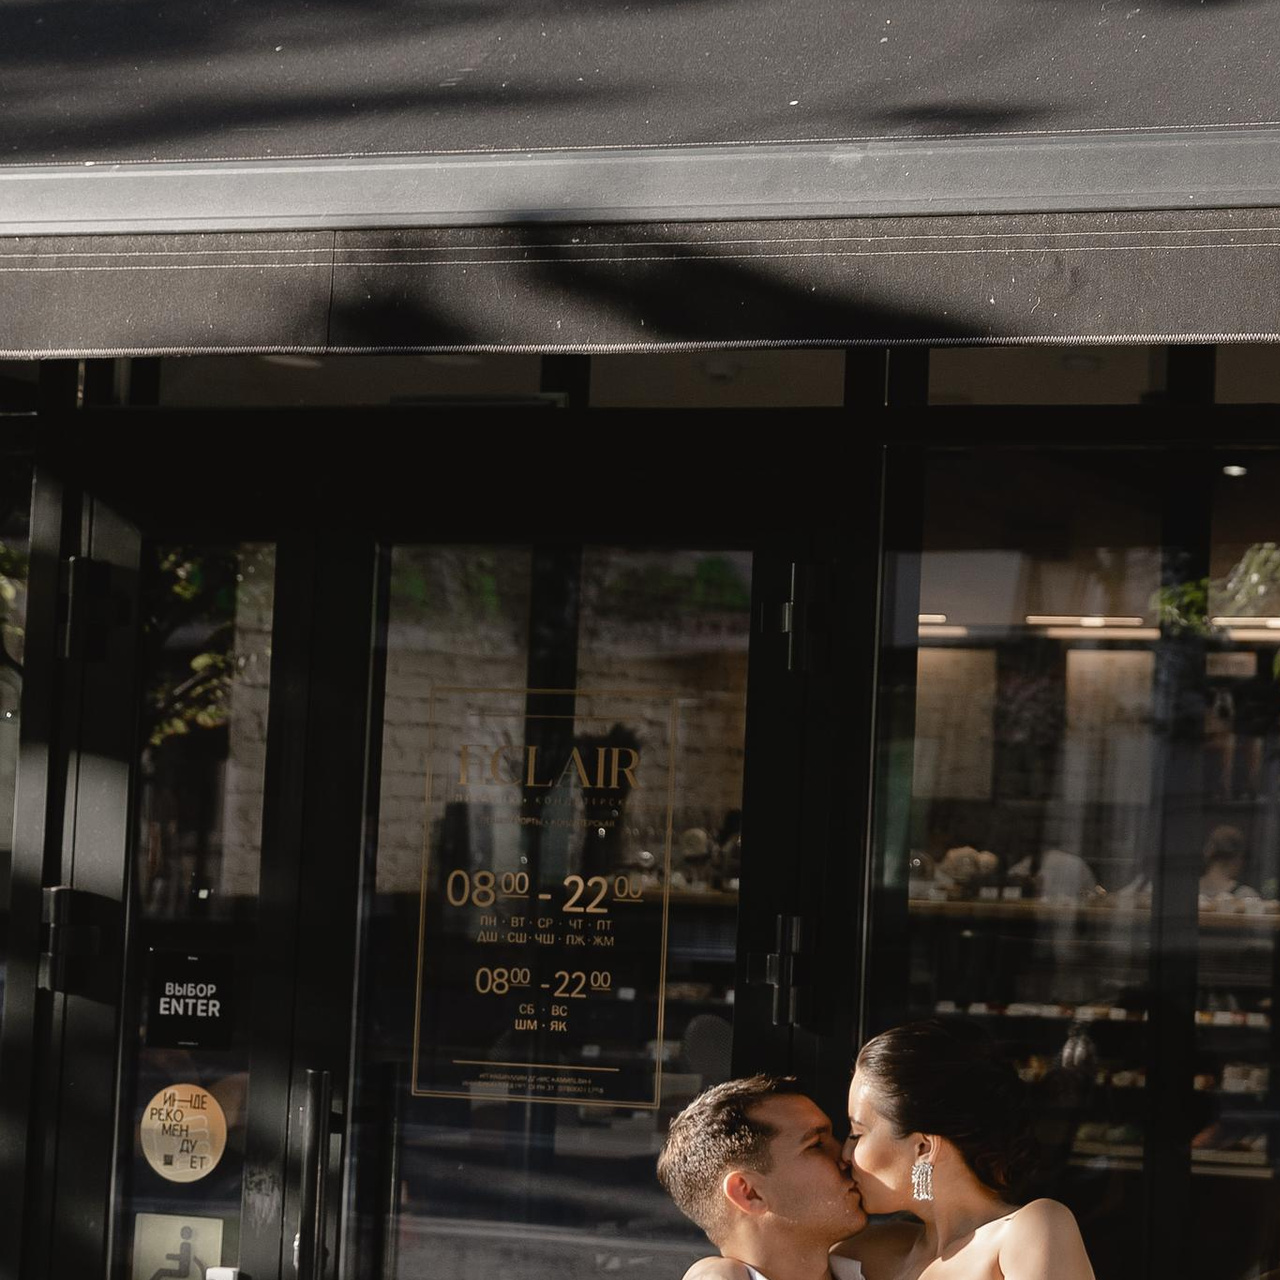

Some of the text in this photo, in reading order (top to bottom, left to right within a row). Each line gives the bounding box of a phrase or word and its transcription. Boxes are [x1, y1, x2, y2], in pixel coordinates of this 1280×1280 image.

[480, 915, 613, 931] ПН ВТ СР ЧТ ПТ
[476, 931, 498, 944] ДШ
[507, 932, 526, 944] СШ
[534, 933, 555, 945] ЧШ
[164, 981, 217, 998] ВЫБОР
[158, 996, 221, 1018] ENTER
[519, 1003, 568, 1017] СБ ВС
[514, 1019, 568, 1031] ШМ ЯК
[150, 1107, 184, 1123] РЕКО
[161, 1123, 190, 1138] МЕН
[179, 1139, 198, 1154] ДУ
[190, 1155, 207, 1170] ЕТ
